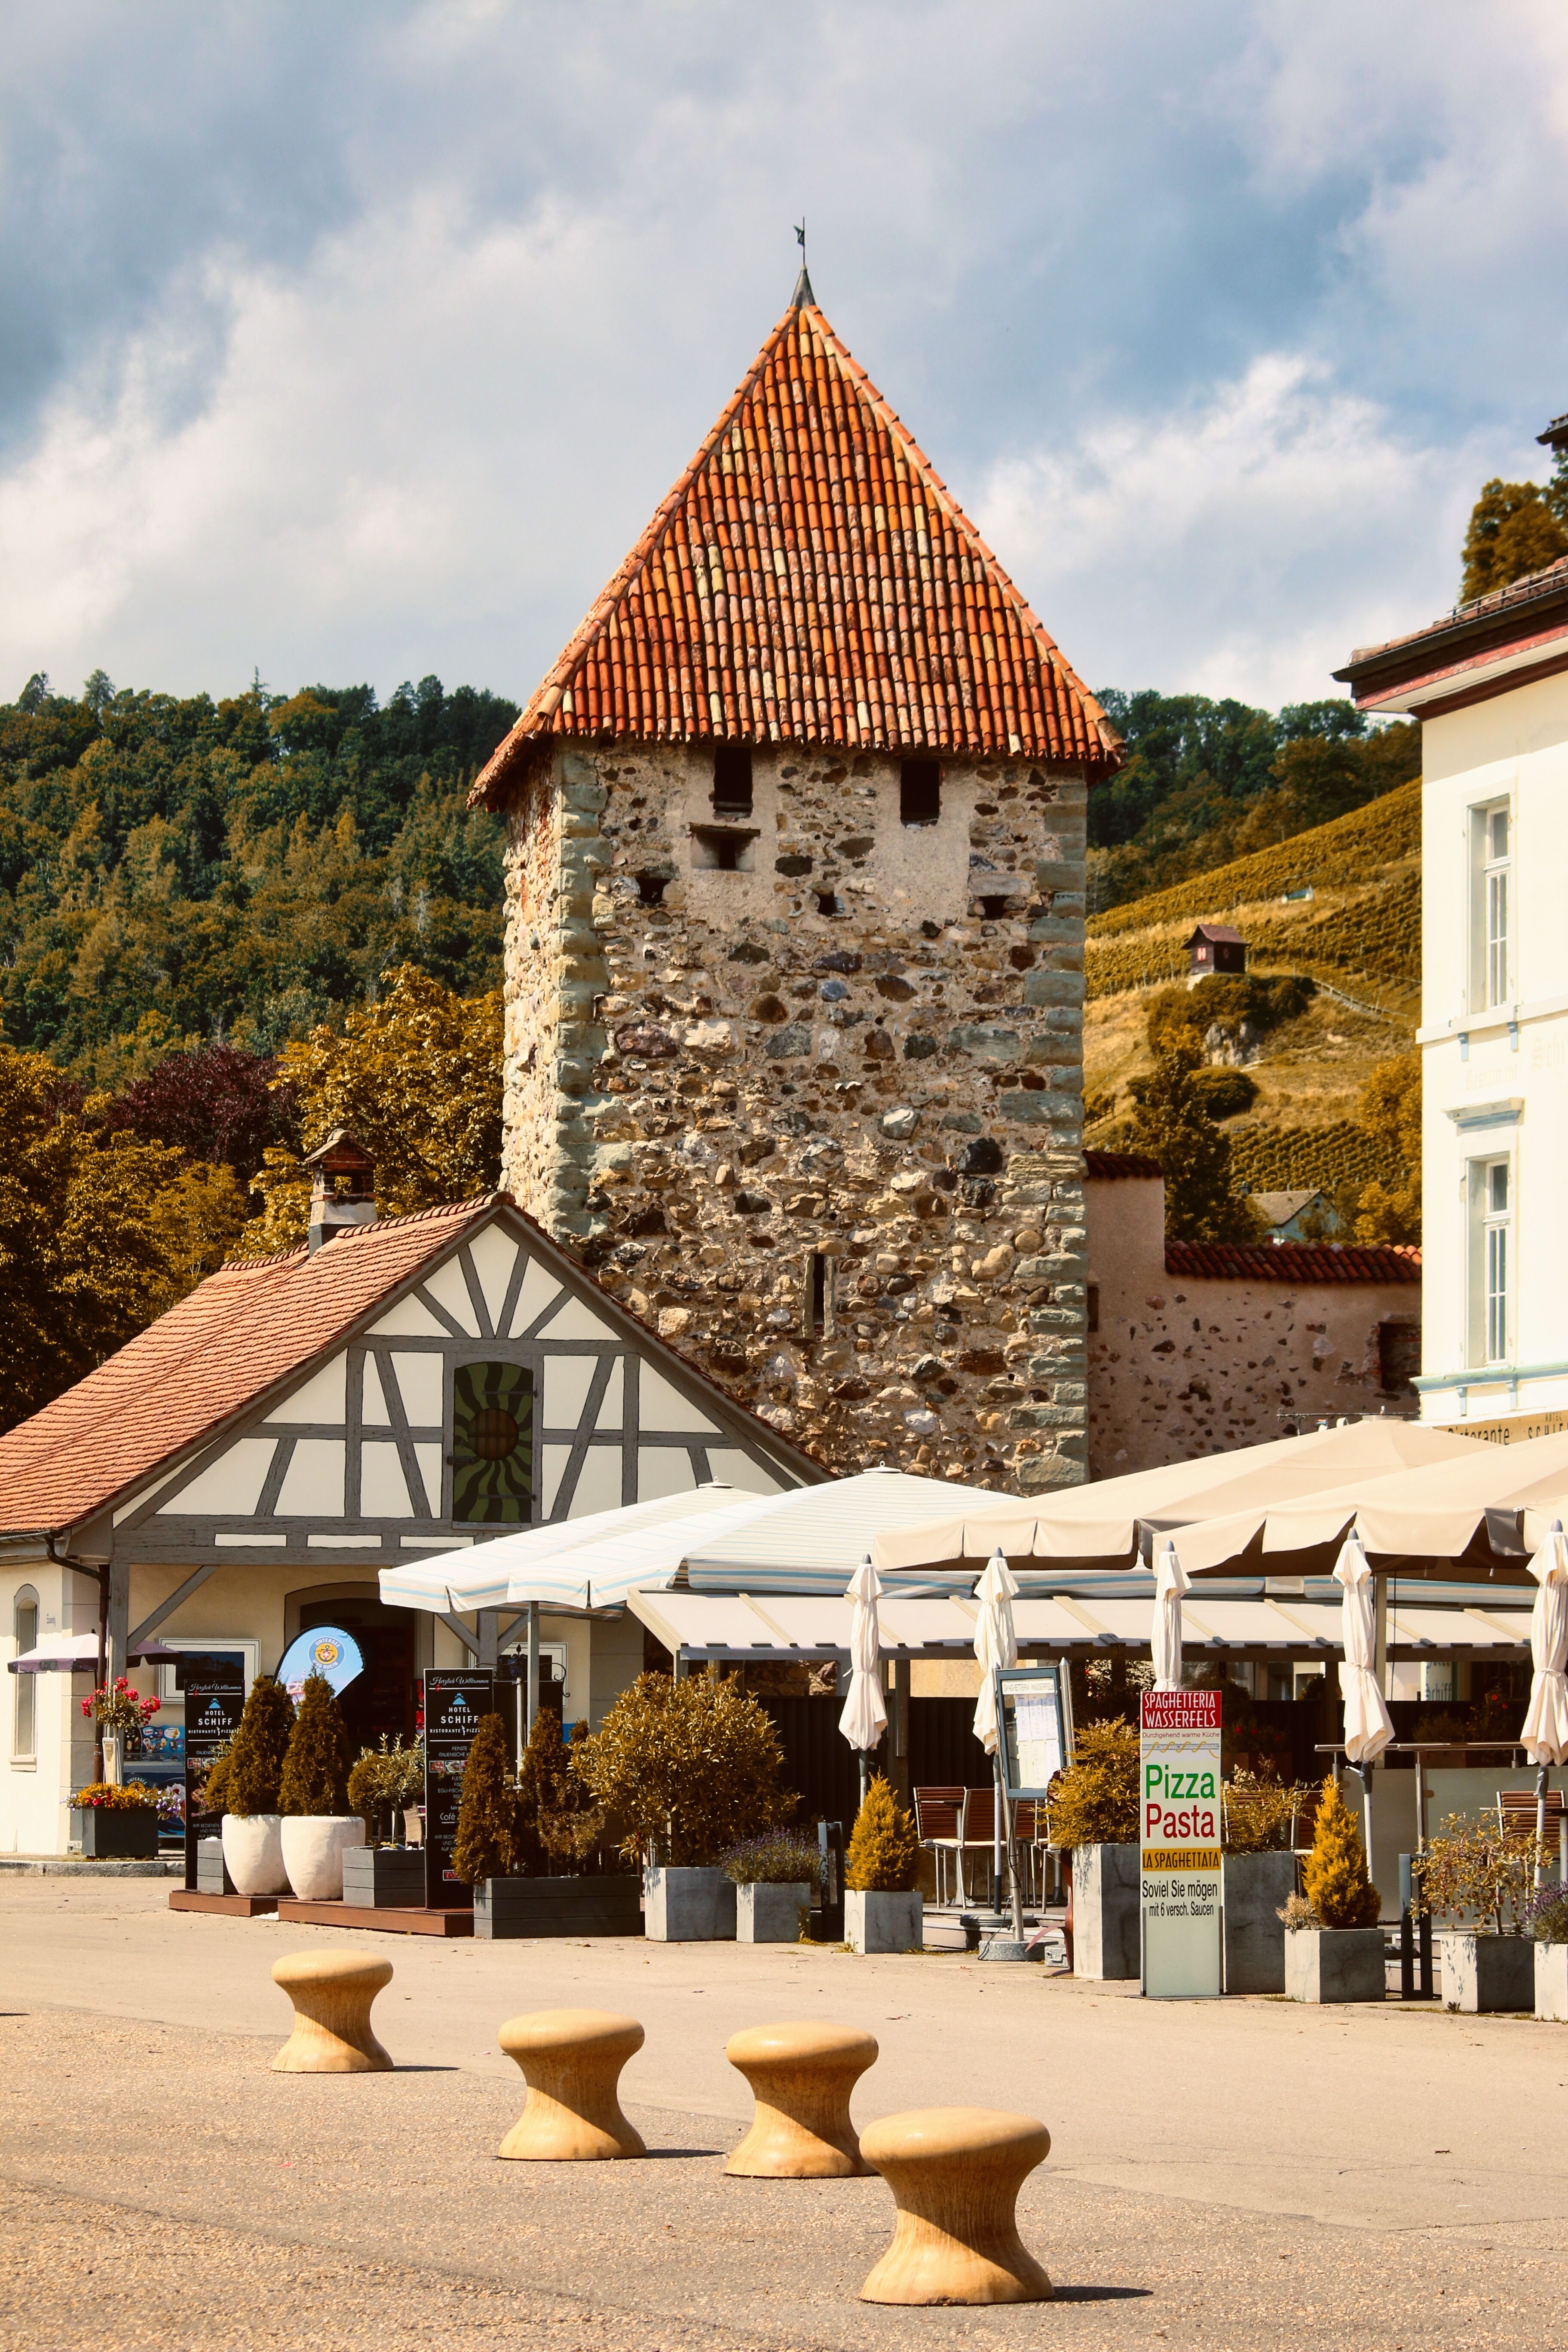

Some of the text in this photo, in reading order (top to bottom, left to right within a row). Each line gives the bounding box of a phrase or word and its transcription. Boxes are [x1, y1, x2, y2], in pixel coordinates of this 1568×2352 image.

[1530, 1032, 1568, 1076] Schi
[315, 1638, 341, 1648] UNTERSEE
[323, 1661, 338, 1669] RHEIN
[430, 1677, 454, 1685] Herzlich
[1145, 1693, 1216, 1709] SPAGHETTERIA
[1145, 1710, 1216, 1728] WASSERFELS
[126, 1777, 147, 1785] UNTERSEE
[1146, 1764, 1216, 1799] Pizza
[1146, 1804, 1215, 1838] Pasta
[1143, 1852, 1219, 1868] LA SPAGHETTATA
[1142, 1880, 1217, 1901] Soviel Sie mögen
[1149, 1901, 1214, 1917] mit 6 versch. Saucen
